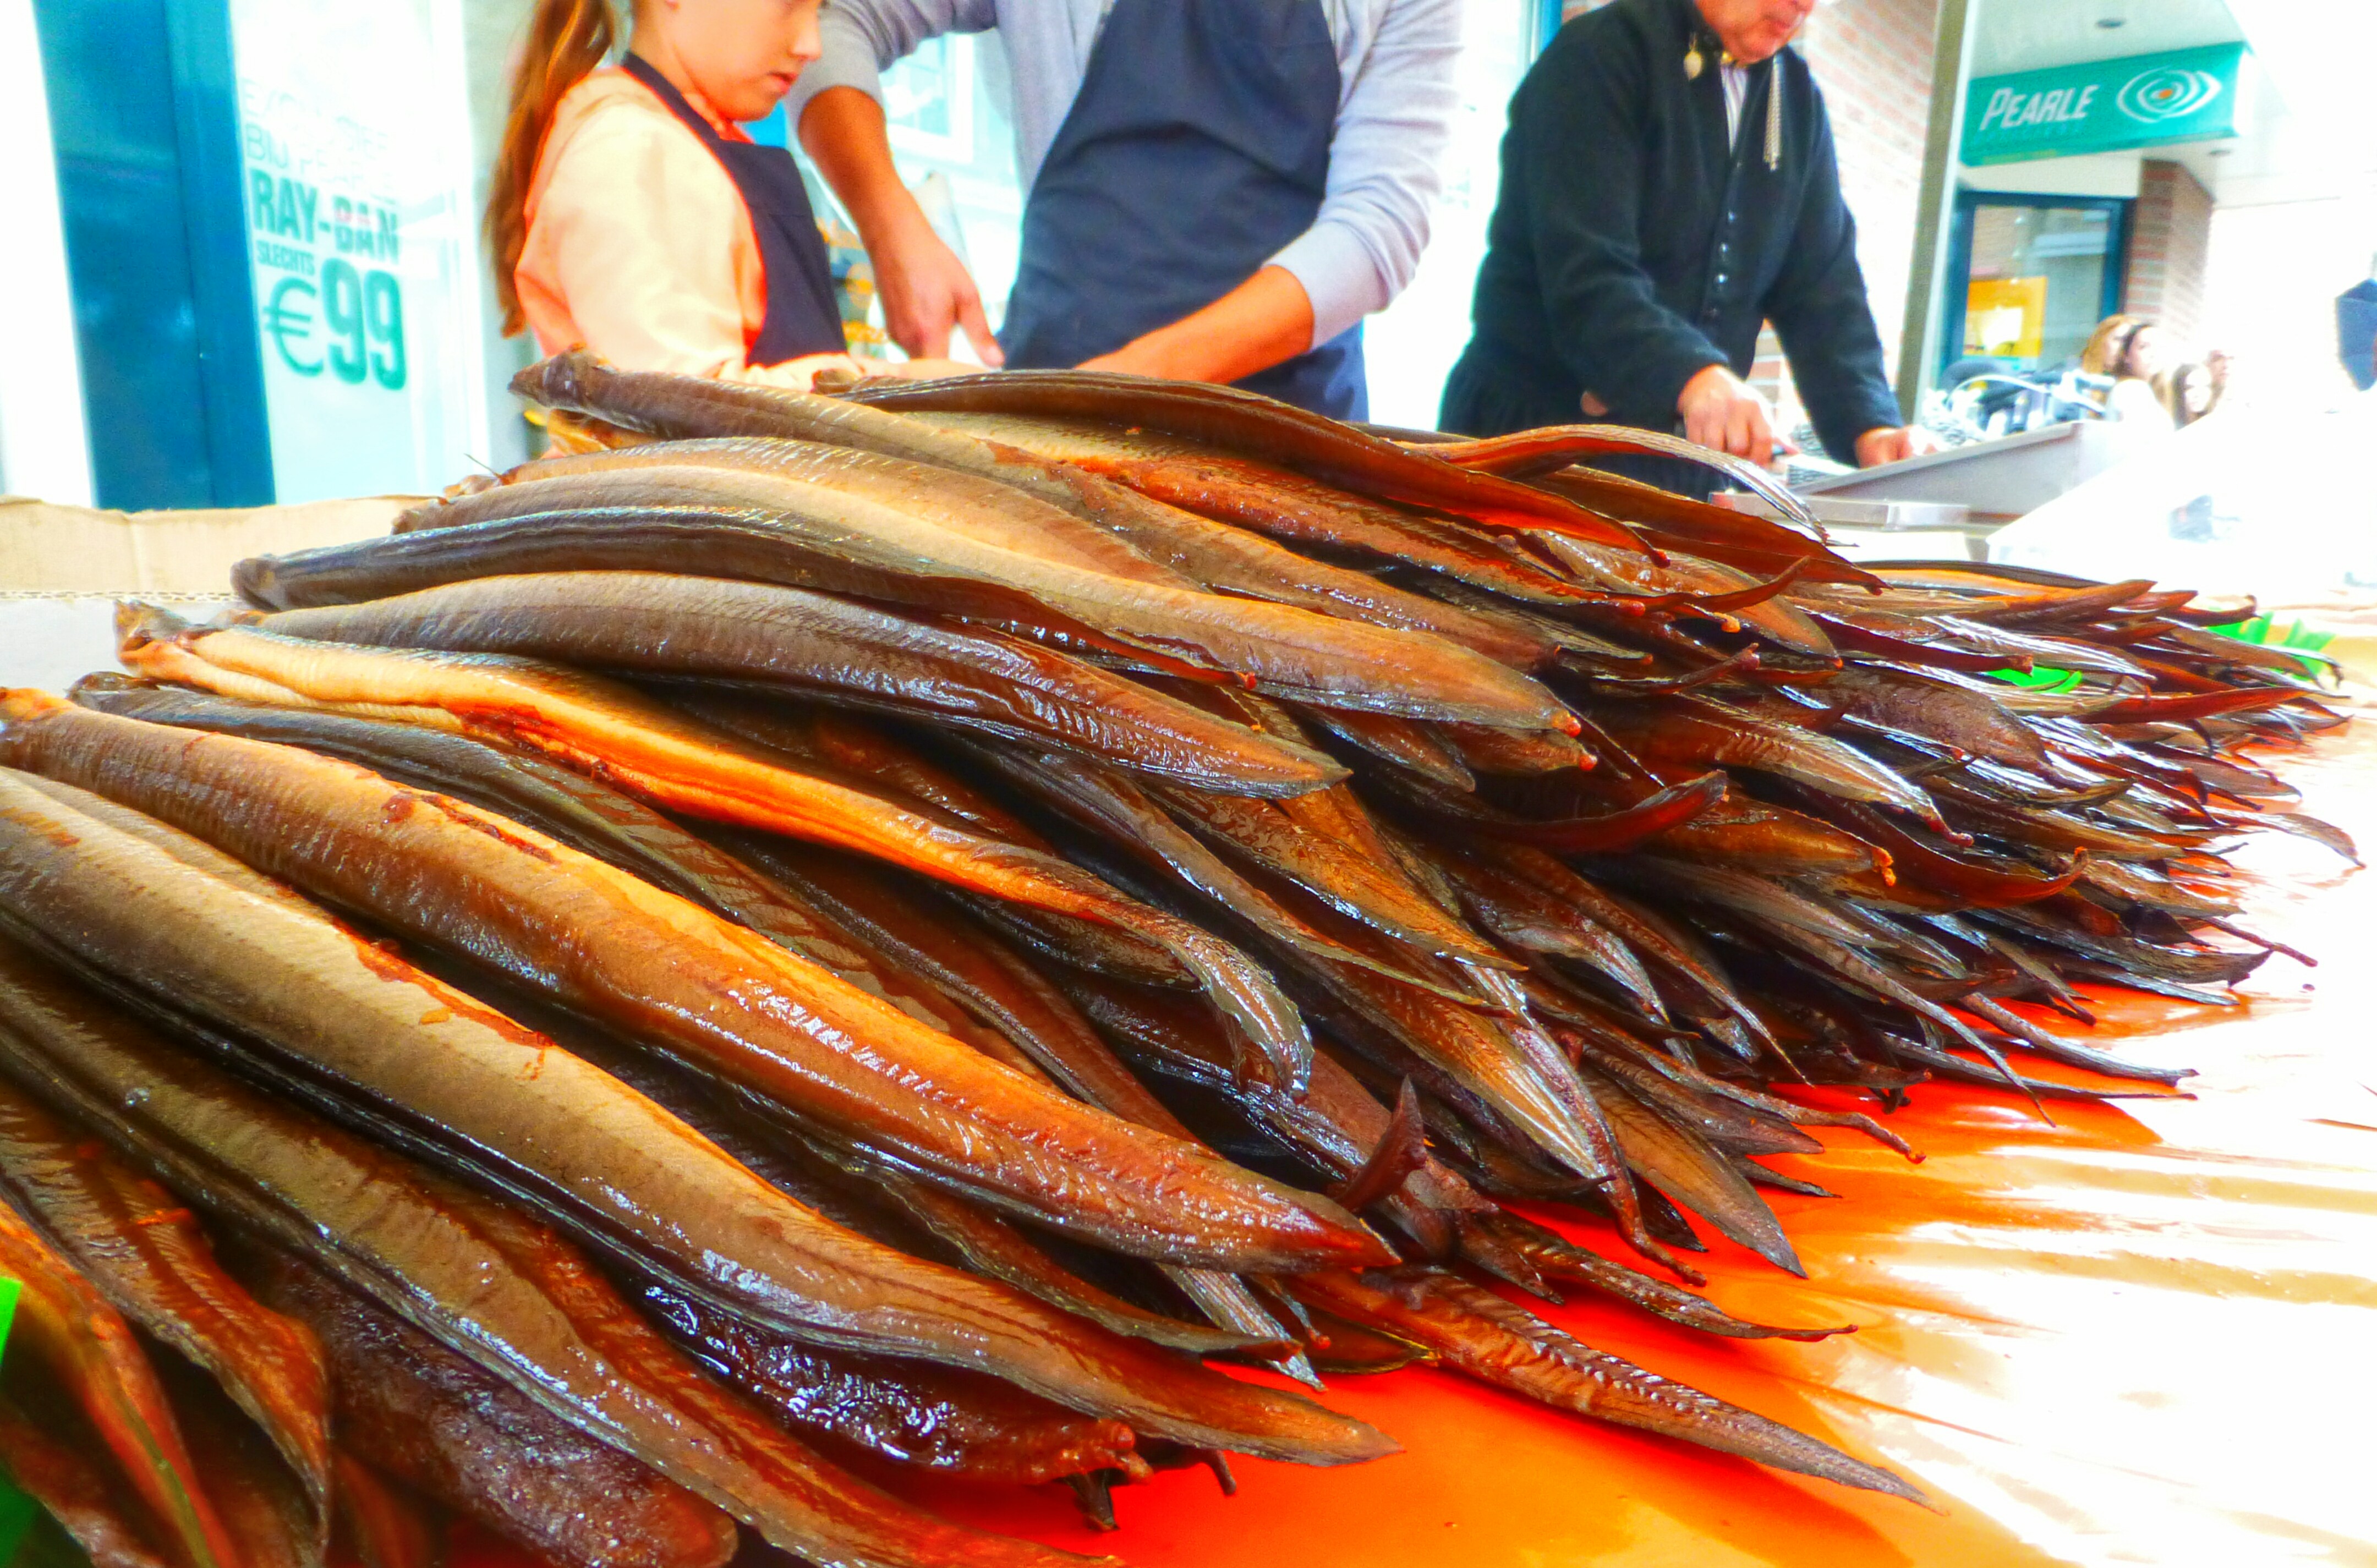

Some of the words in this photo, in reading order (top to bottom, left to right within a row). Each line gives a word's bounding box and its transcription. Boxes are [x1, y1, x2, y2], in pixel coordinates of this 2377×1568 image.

[1979, 84, 2100, 131] PEARLE
[250, 168, 399, 265] RAY-BAN
[256, 240, 316, 276] SLECHTS
[263, 257, 407, 391] €99
